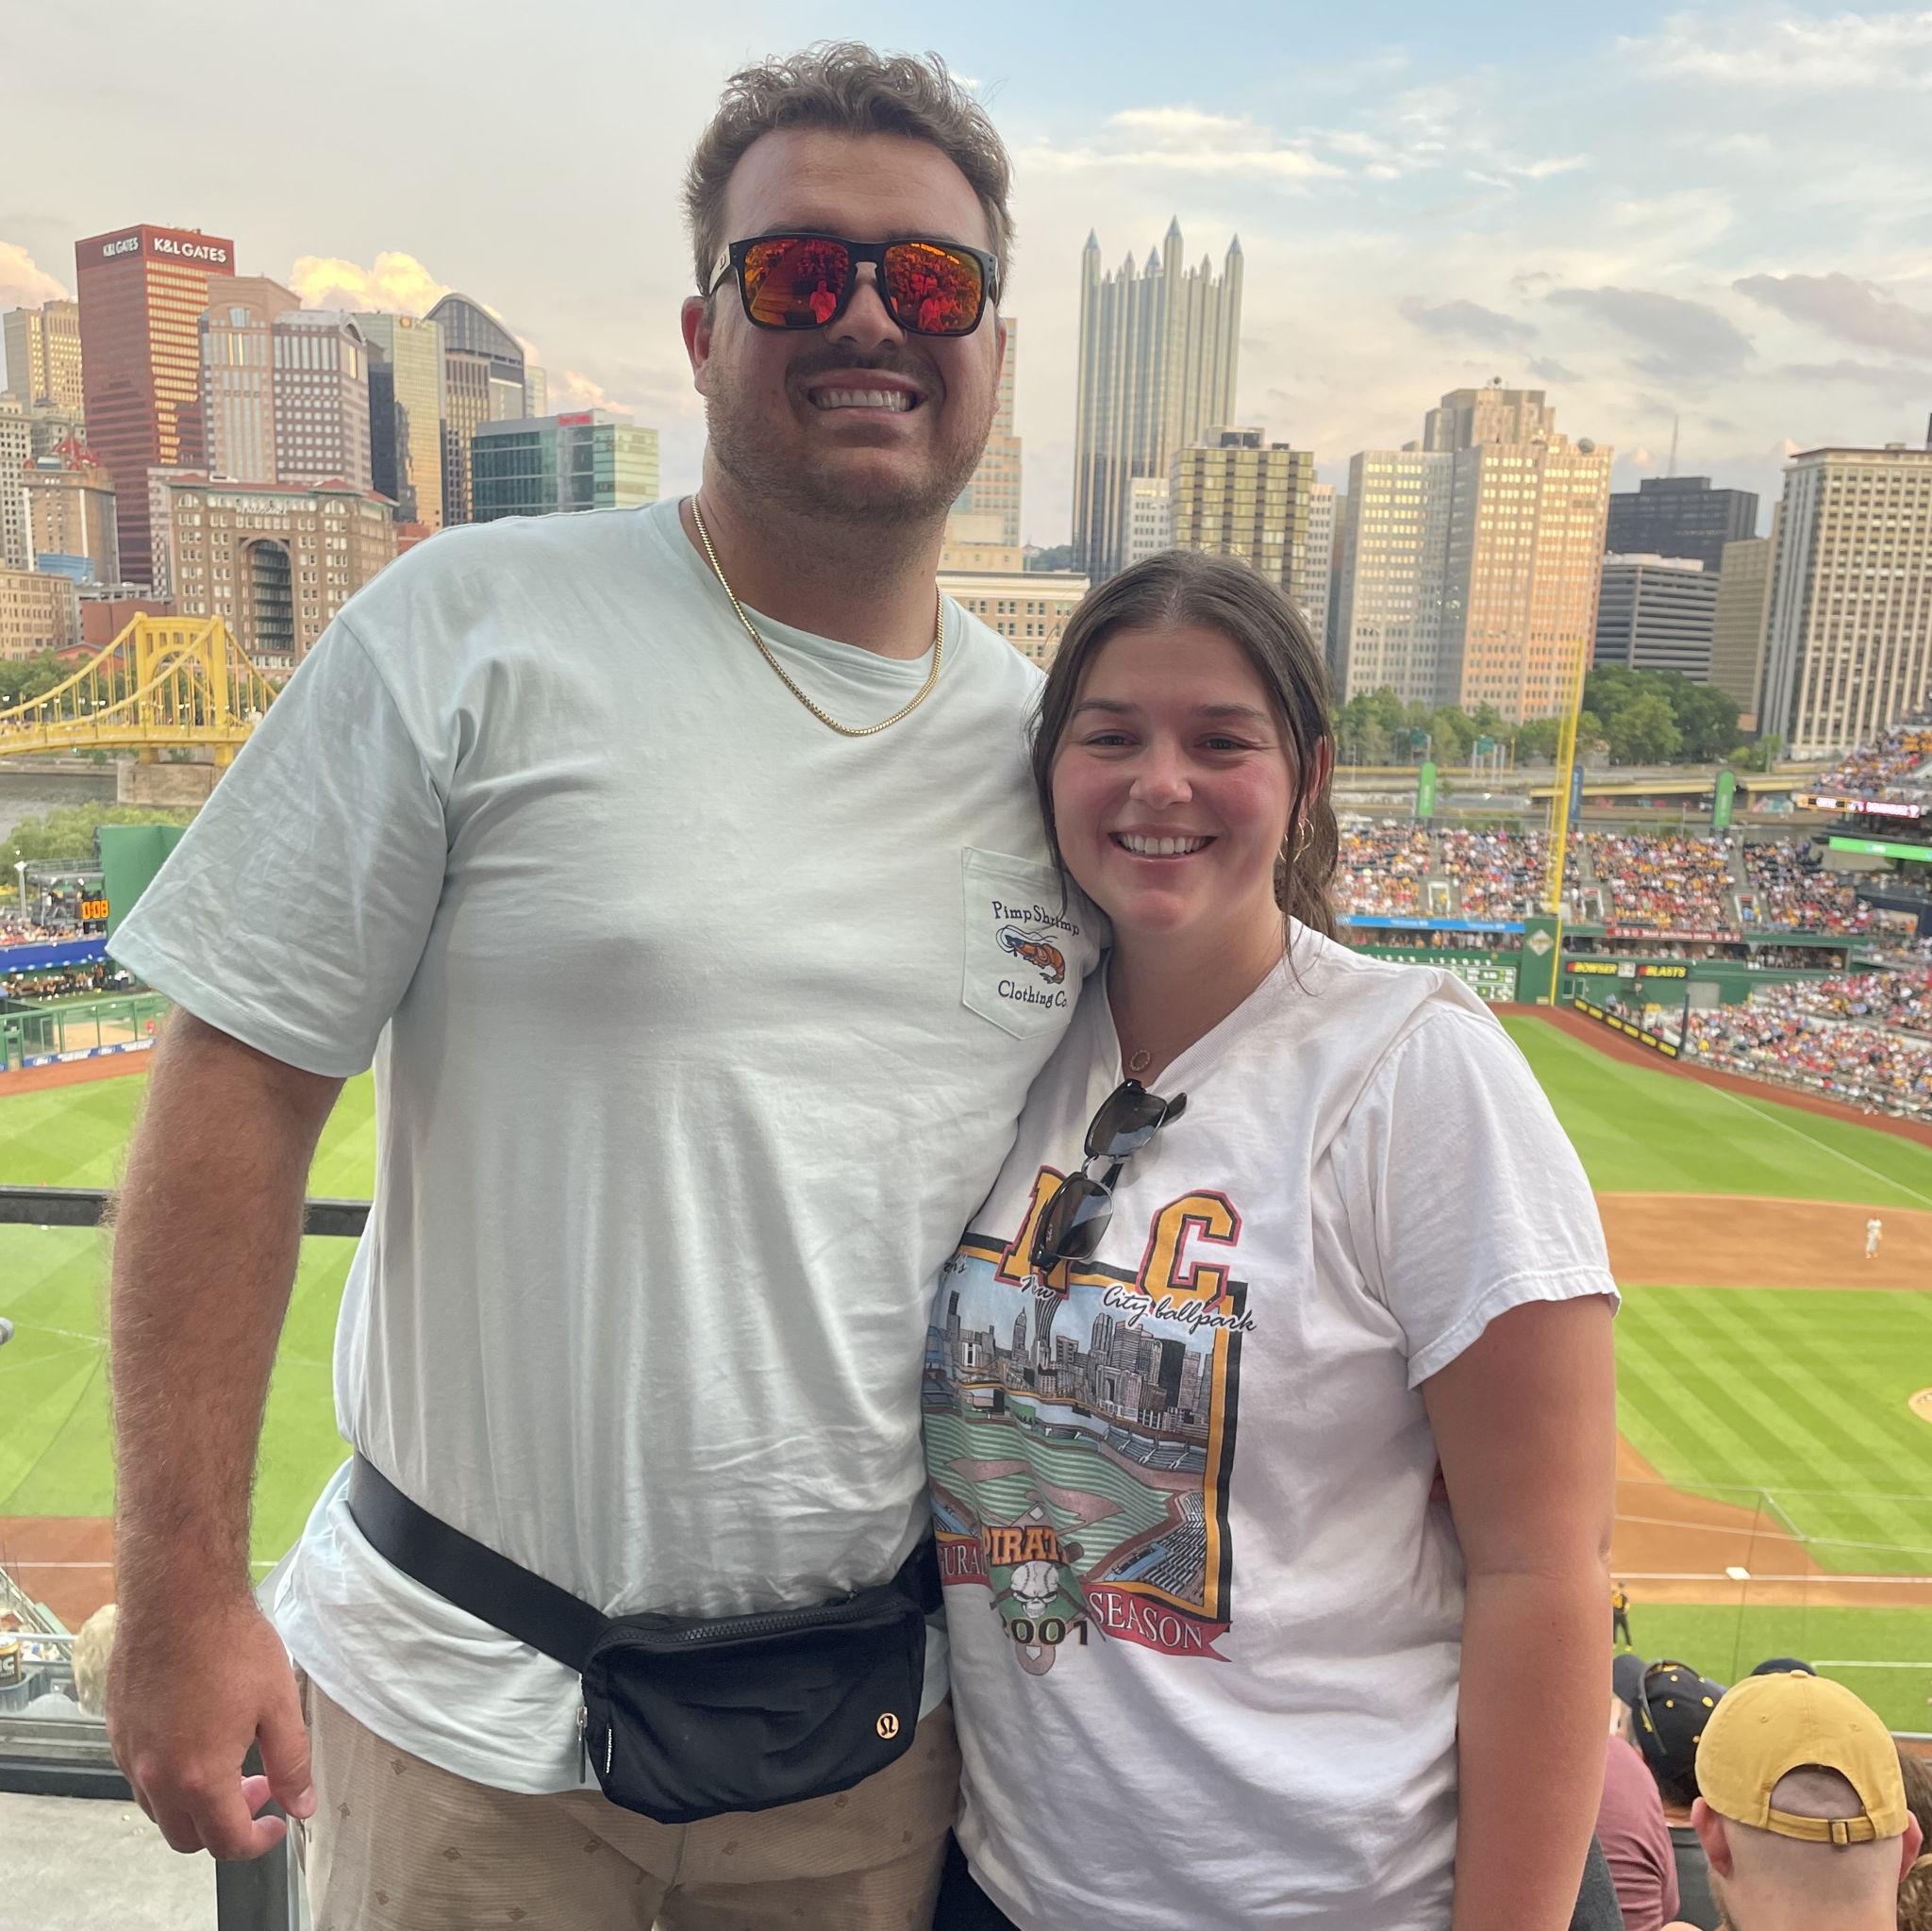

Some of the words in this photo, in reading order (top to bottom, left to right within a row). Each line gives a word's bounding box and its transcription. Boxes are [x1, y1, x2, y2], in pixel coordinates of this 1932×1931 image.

[154, 238, 180, 255] K&L
[181, 242, 226, 263] GATES
[991, 900, 1032, 924] Pimp
[1033, 905, 1080, 936] Shrimp
[1645, 965, 1687, 977] BLASTS
[997, 979, 1054, 1008] Clothing
[1103, 1285, 1150, 1326] City
[1155, 1296, 1257, 1336] ballpark
[1001, 1614, 1089, 1646] 001
[1089, 1591, 1204, 1649] SEASON
